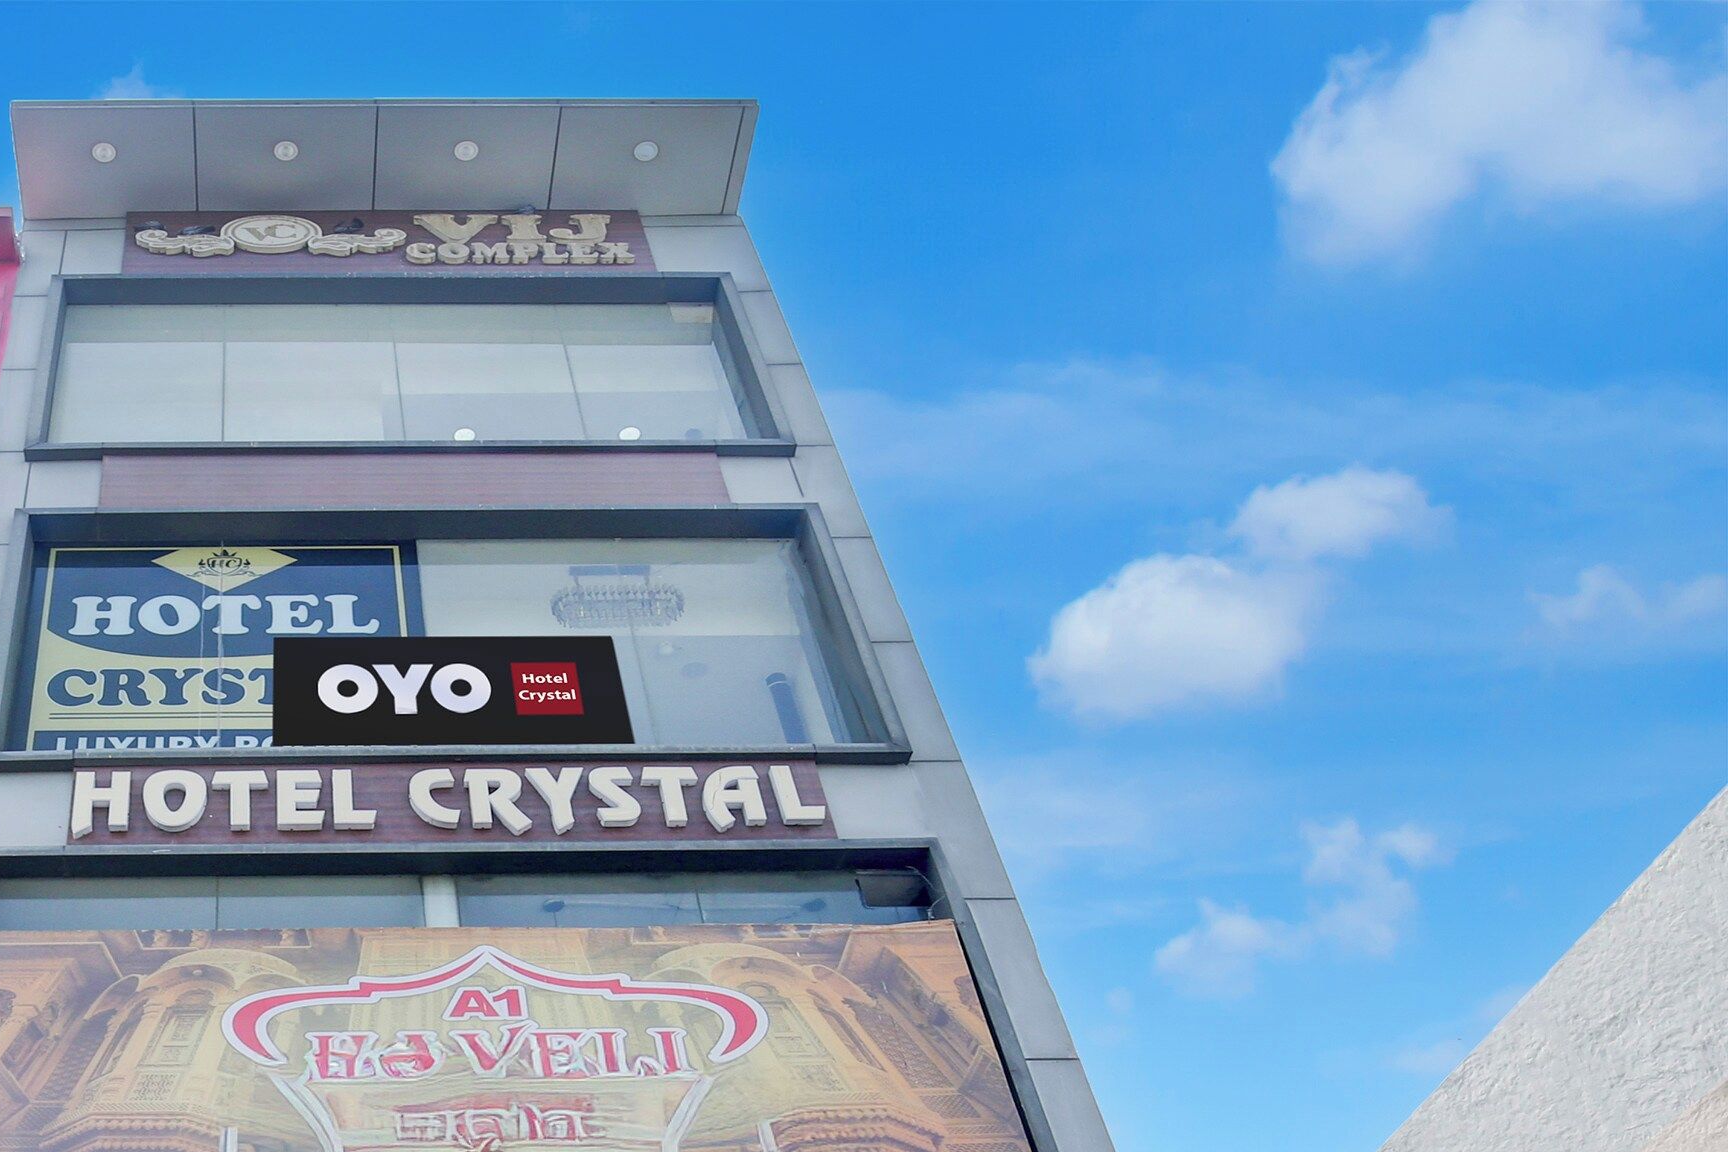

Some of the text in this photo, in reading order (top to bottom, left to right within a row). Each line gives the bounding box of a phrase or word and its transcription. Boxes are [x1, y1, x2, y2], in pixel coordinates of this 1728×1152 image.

[411, 212, 611, 244] VIJ
[404, 241, 637, 266] COMPLEX
[67, 593, 381, 637] HOTEL
[316, 662, 492, 715] OYO
[518, 687, 578, 704] Crystal
[521, 671, 569, 686] Hotel
[72, 764, 827, 839] HOTEL CRYSTAL
[442, 985, 529, 1021] A1
